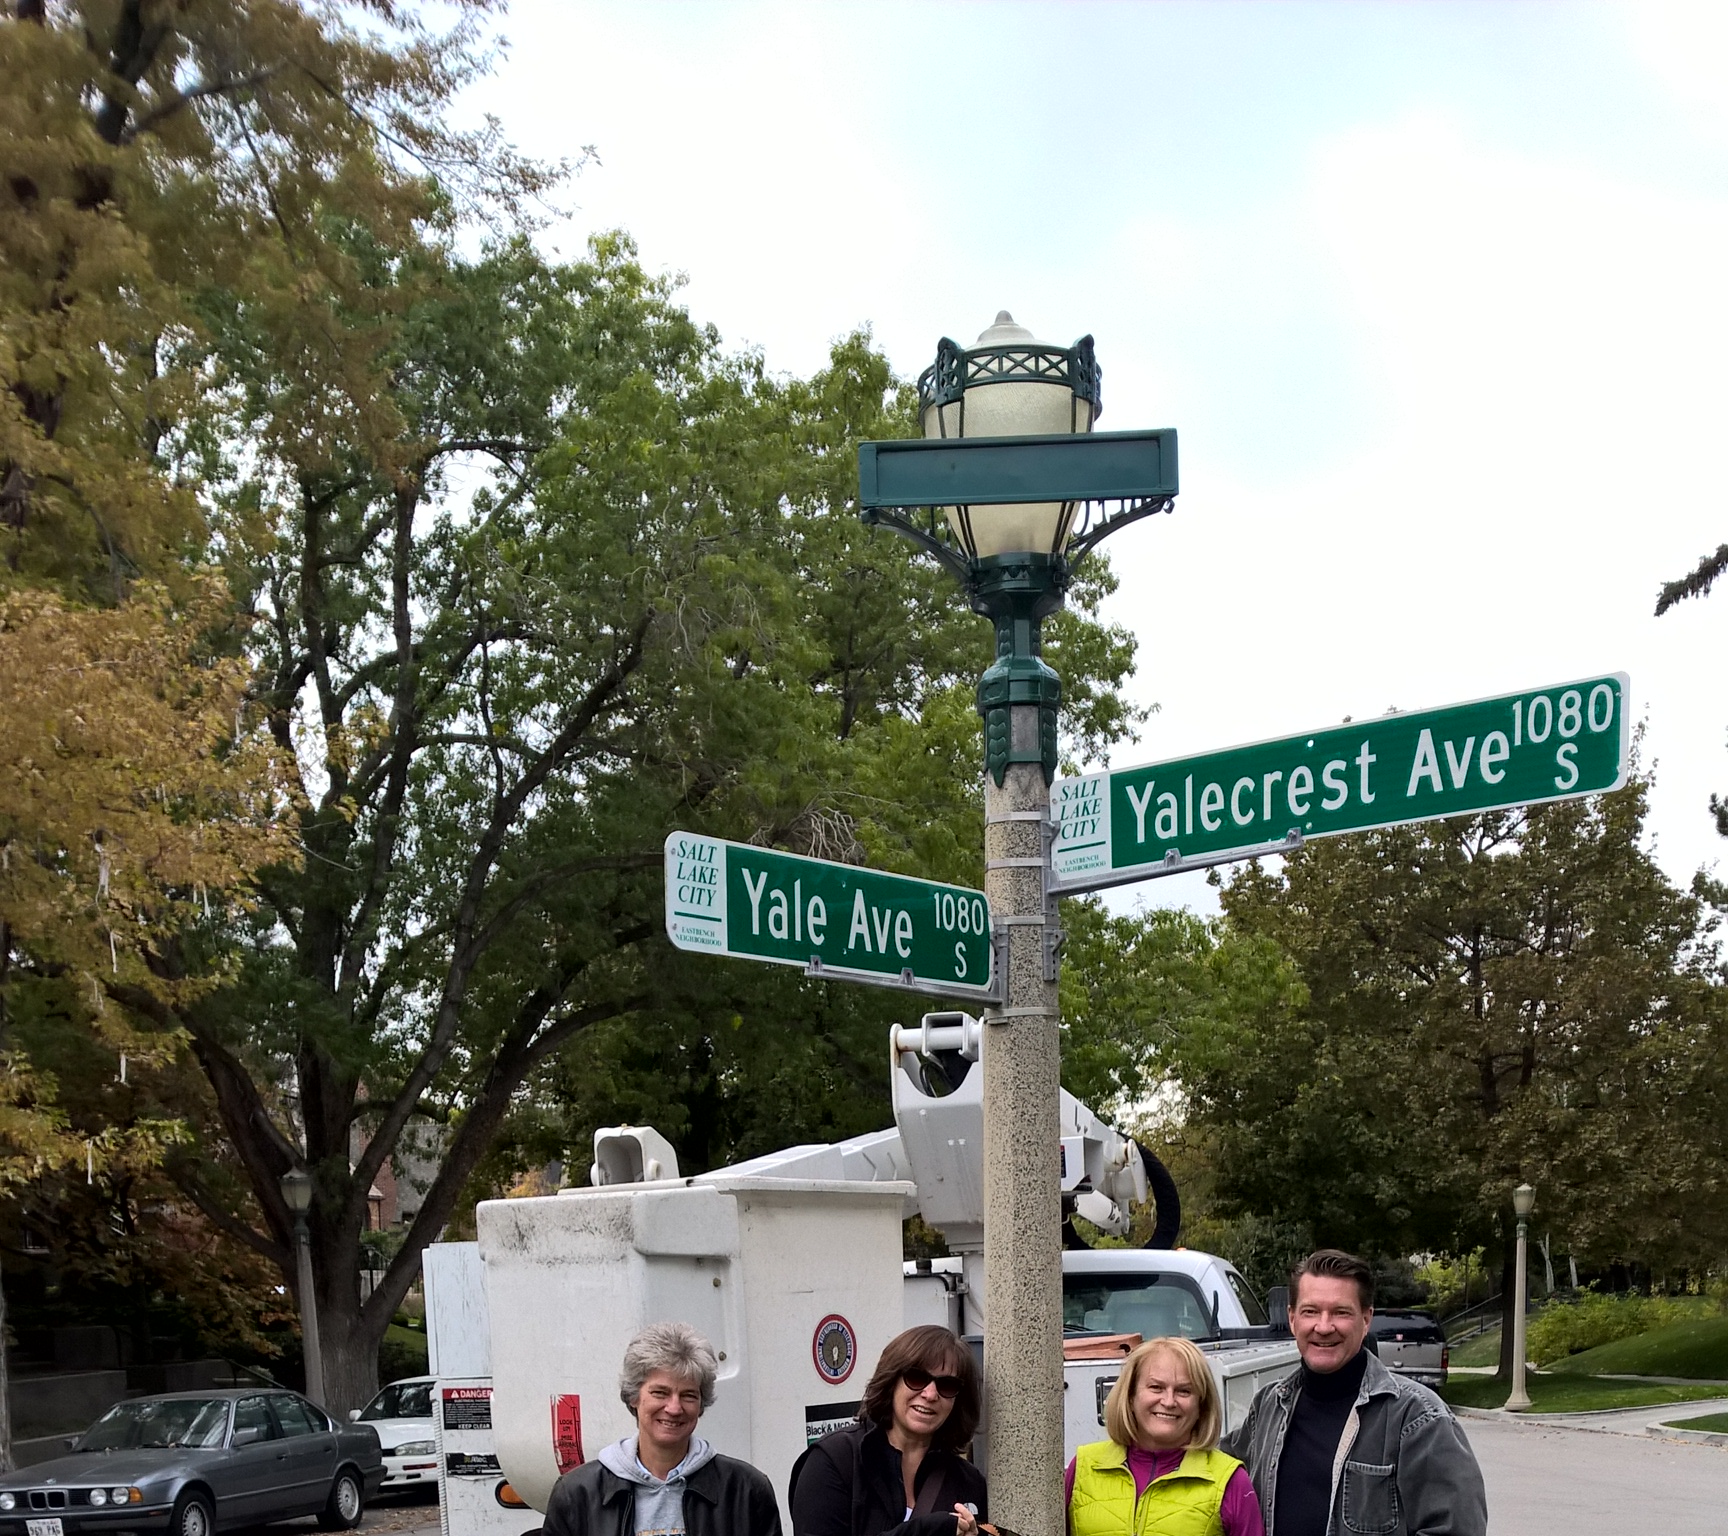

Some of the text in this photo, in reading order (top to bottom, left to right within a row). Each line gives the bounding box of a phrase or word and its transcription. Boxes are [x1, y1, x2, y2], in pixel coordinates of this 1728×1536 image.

[1512, 684, 1614, 748] 1080
[1554, 743, 1579, 791] S
[1060, 779, 1101, 802] SALT
[1124, 728, 1510, 843] Yalecrest Ave
[1060, 798, 1103, 821] LAKE
[1061, 818, 1101, 840] CITY
[677, 840, 717, 863] SALT
[1065, 855, 1099, 867] EASTBENCH
[676, 862, 719, 886] LAKE
[1059, 861, 1106, 874] NEIGHBORHOOD
[678, 884, 717, 907] CITY
[741, 868, 913, 958] Yale Ave
[934, 892, 984, 936] 1080
[675, 934, 722, 946] NEIGHBORHOOD
[681, 926, 715, 938] EASTBENCH
[954, 941, 967, 978] S
[806, 1423, 825, 1437] Black
[826, 1423, 832, 1432] &
